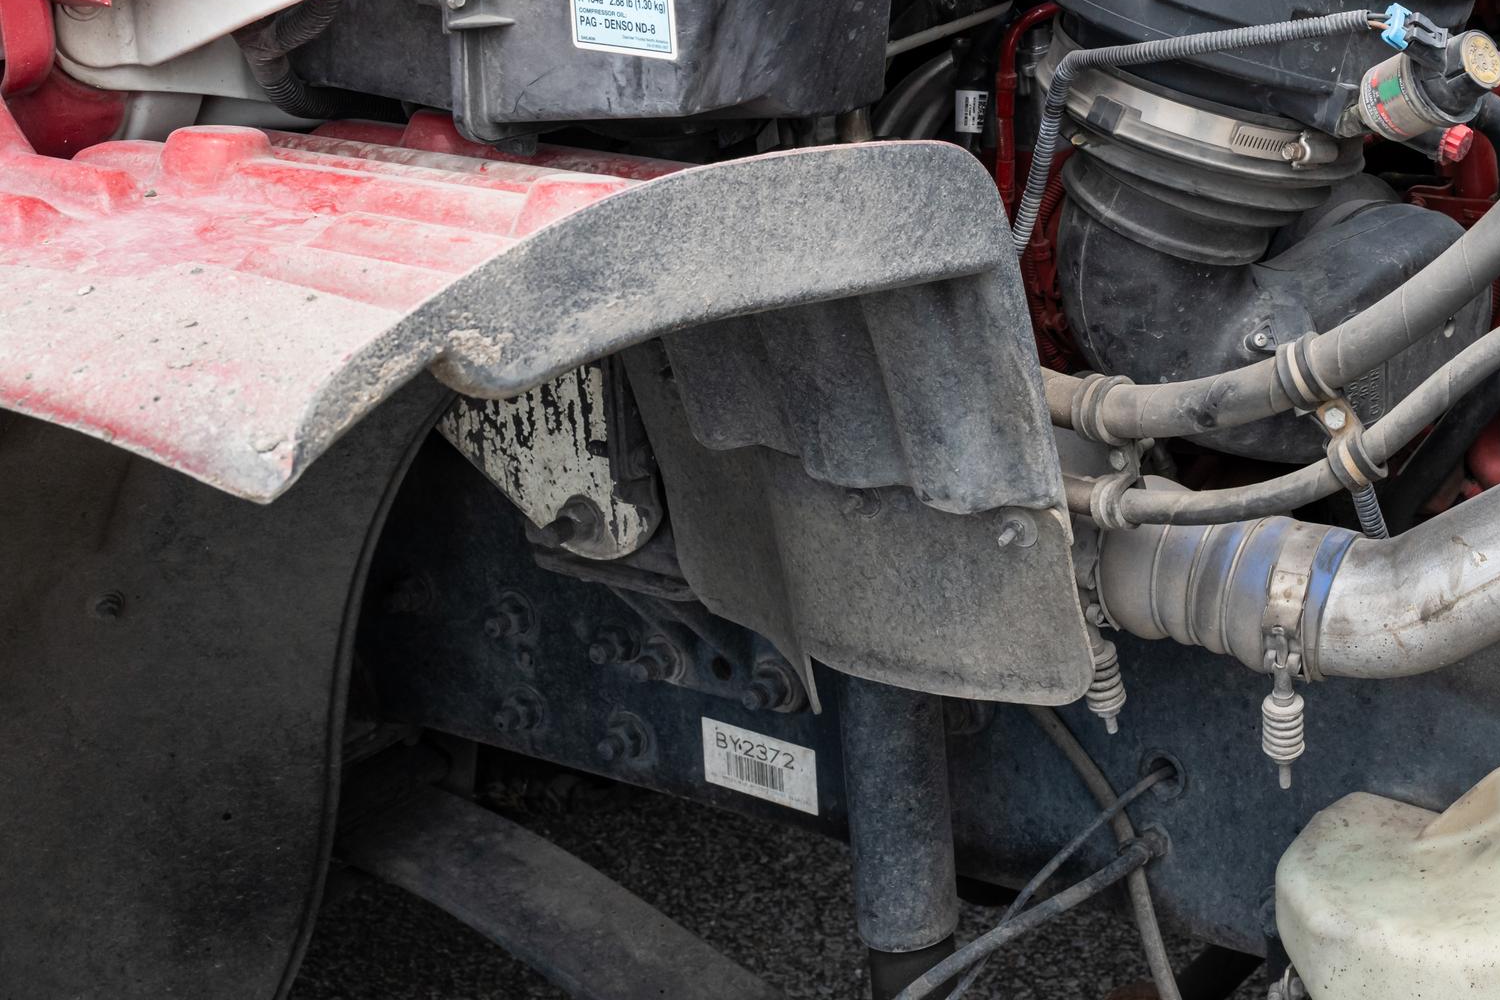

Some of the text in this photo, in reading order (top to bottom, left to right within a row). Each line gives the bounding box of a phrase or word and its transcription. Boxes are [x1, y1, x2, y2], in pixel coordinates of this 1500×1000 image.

[578, 7, 616, 17] COMPRESSOR
[654, 0, 666, 14] kg)
[579, 15, 597, 27] PAG
[604, 19, 633, 32] DENSO
[635, 23, 656, 35] ND-8
[716, 731, 795, 771] BY2372
